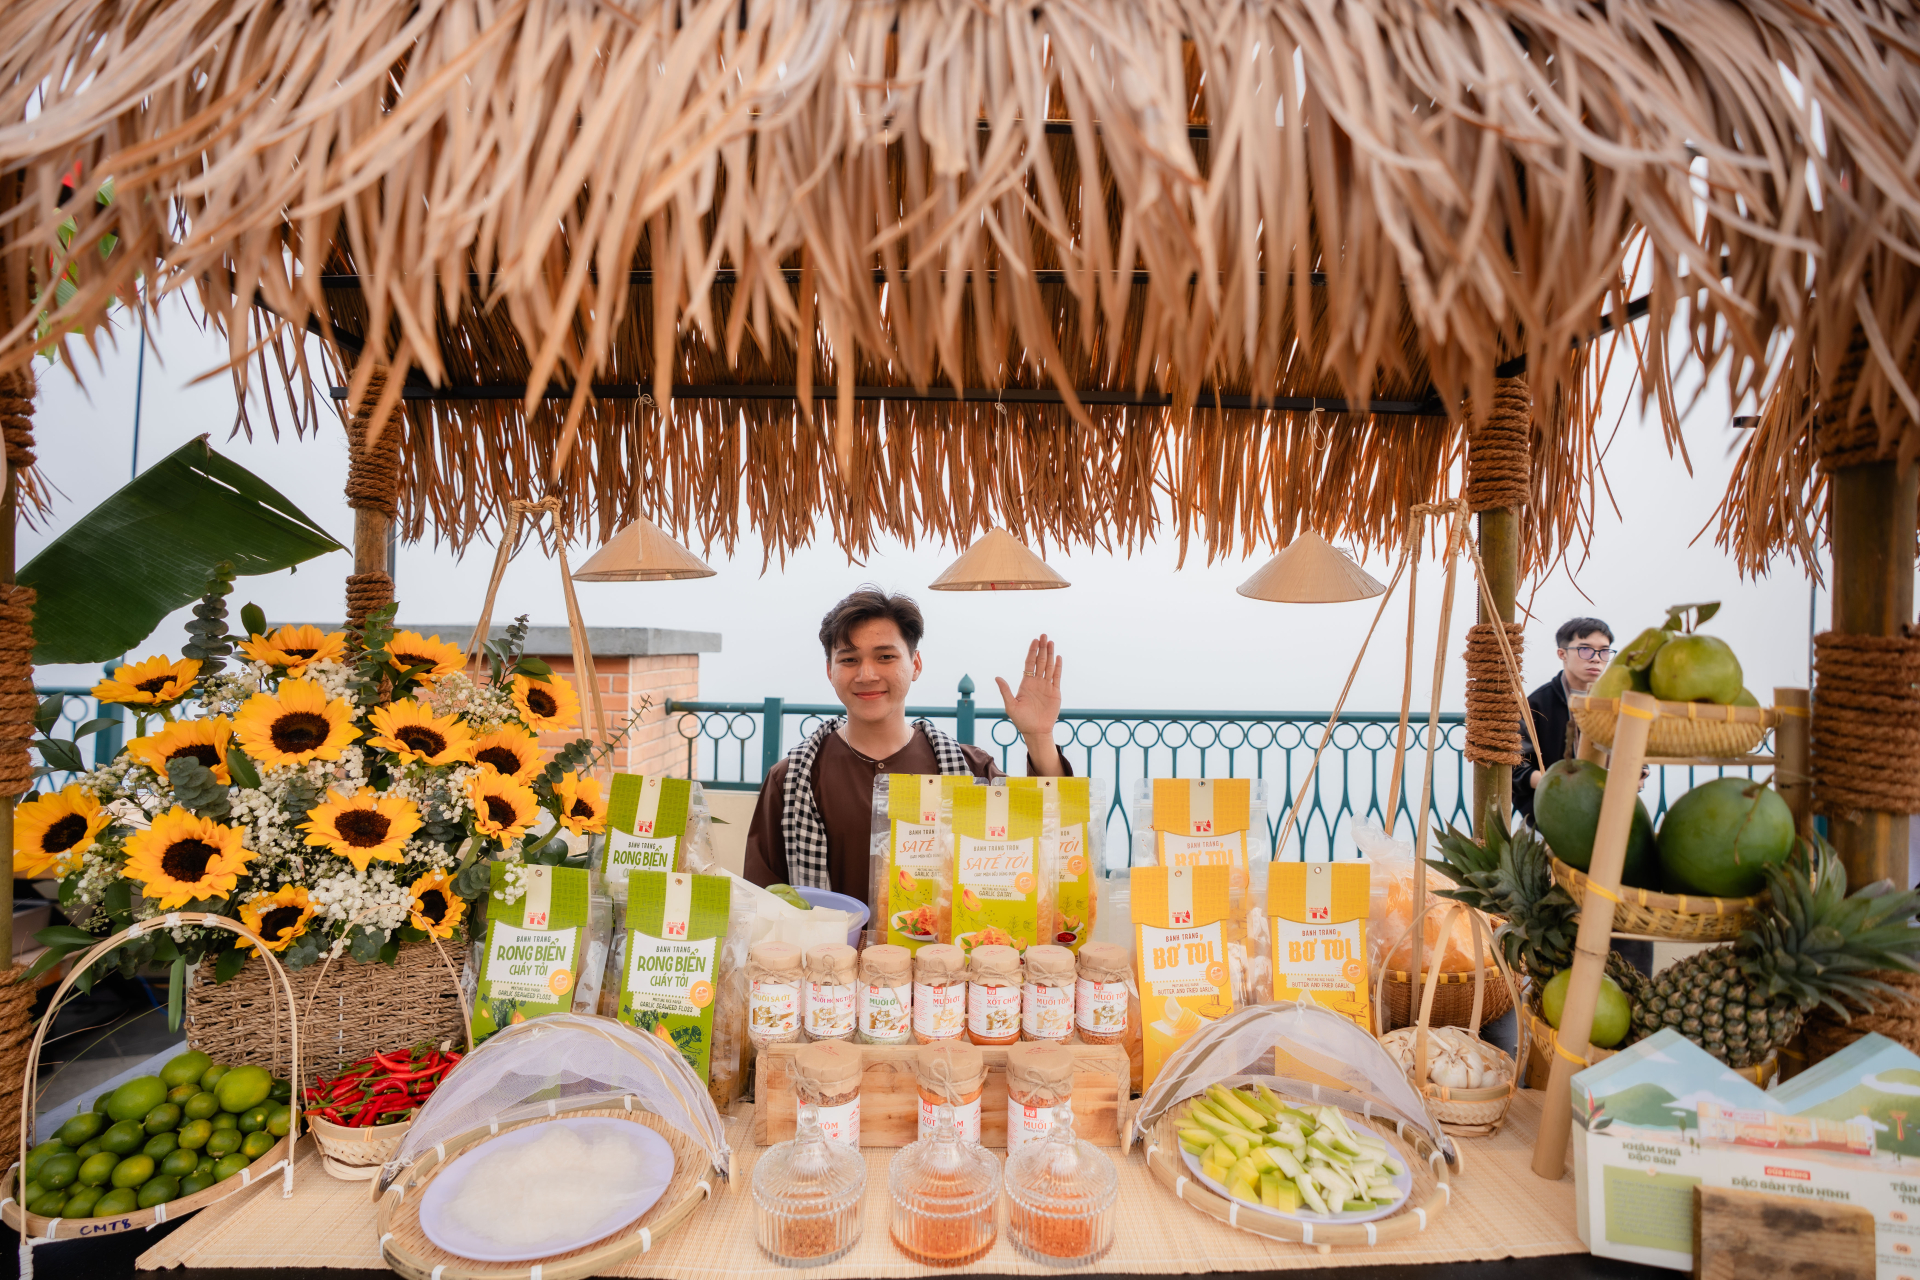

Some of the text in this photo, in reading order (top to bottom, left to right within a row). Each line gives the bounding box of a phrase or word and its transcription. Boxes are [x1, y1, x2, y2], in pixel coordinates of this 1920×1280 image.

[613, 845, 668, 867] RONG BIỂN
[1005, 851, 1029, 870] TỎI
[497, 938, 566, 961] RONG BIỂN
[1153, 934, 1214, 970] BƠ TỎI
[1289, 930, 1352, 962] BƠ TỎI
[509, 962, 548, 976] CHÁY TỎI
[637, 948, 706, 972] RONG BIỂN
[650, 972, 689, 987] CHÁY TỎI
[819, 1122, 838, 1130] TÔM
[80, 1218, 131, 1236] CMT8
